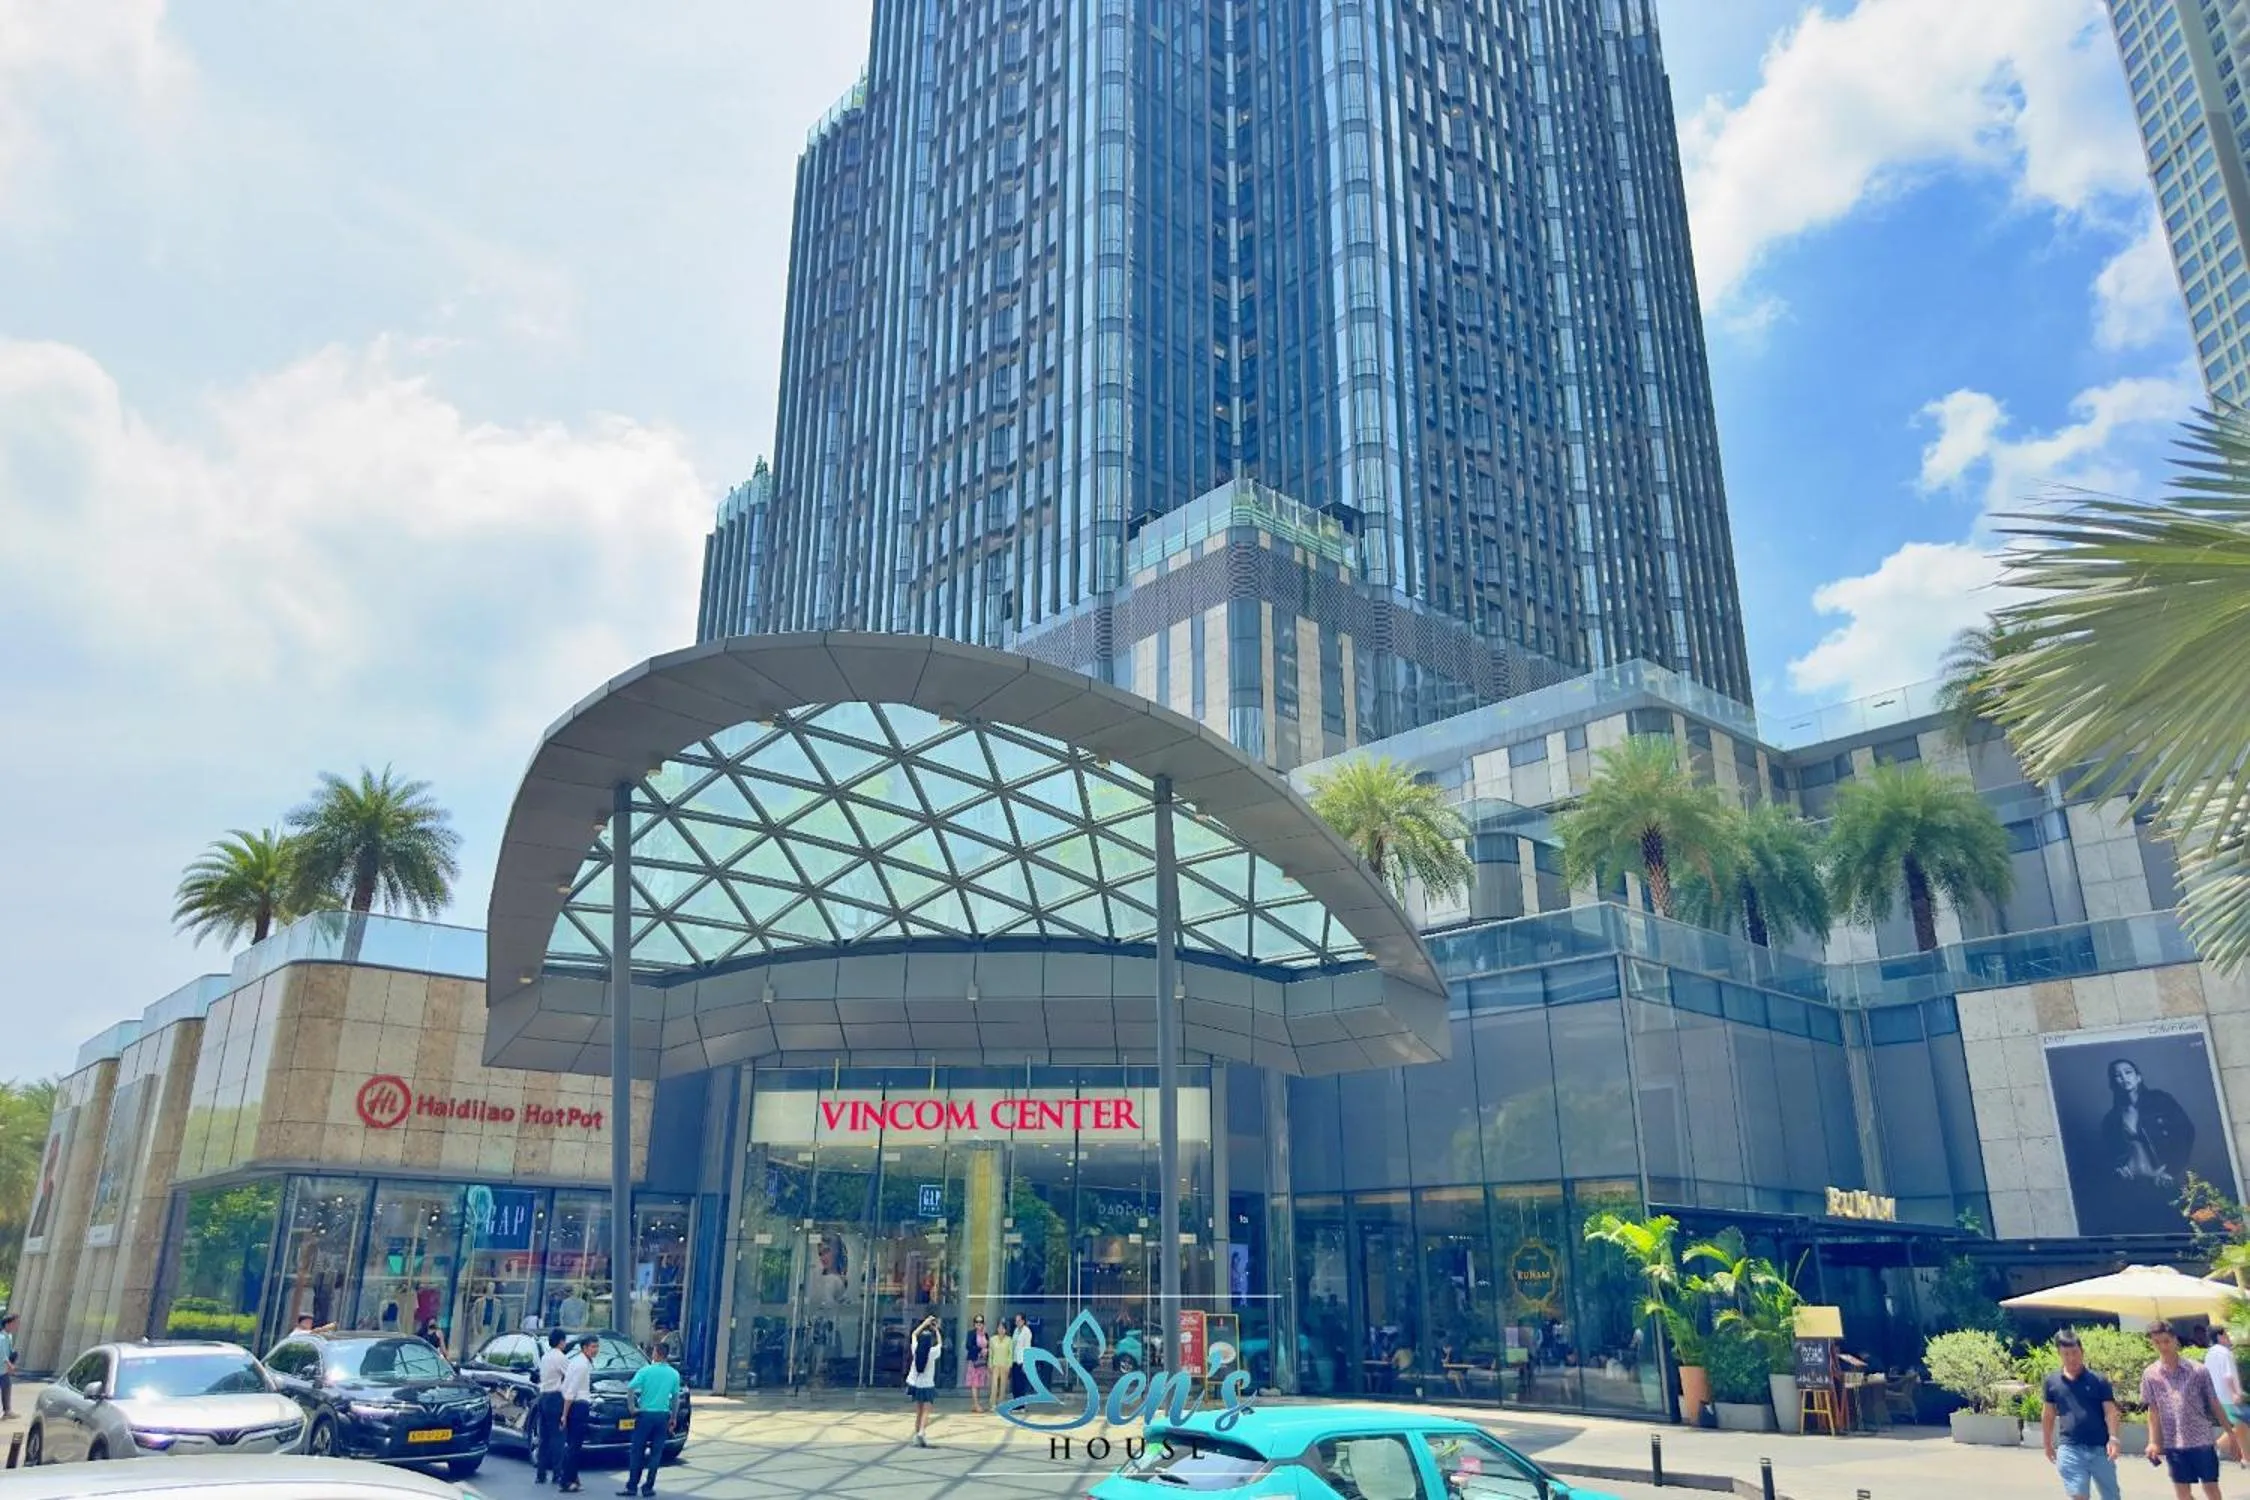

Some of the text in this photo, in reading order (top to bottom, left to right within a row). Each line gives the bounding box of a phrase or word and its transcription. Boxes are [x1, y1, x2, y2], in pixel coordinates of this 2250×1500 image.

[416, 1094, 603, 1130] Haidilao HotPot
[820, 1099, 1140, 1131] VINCOM CENTER
[485, 1205, 525, 1236] GAP
